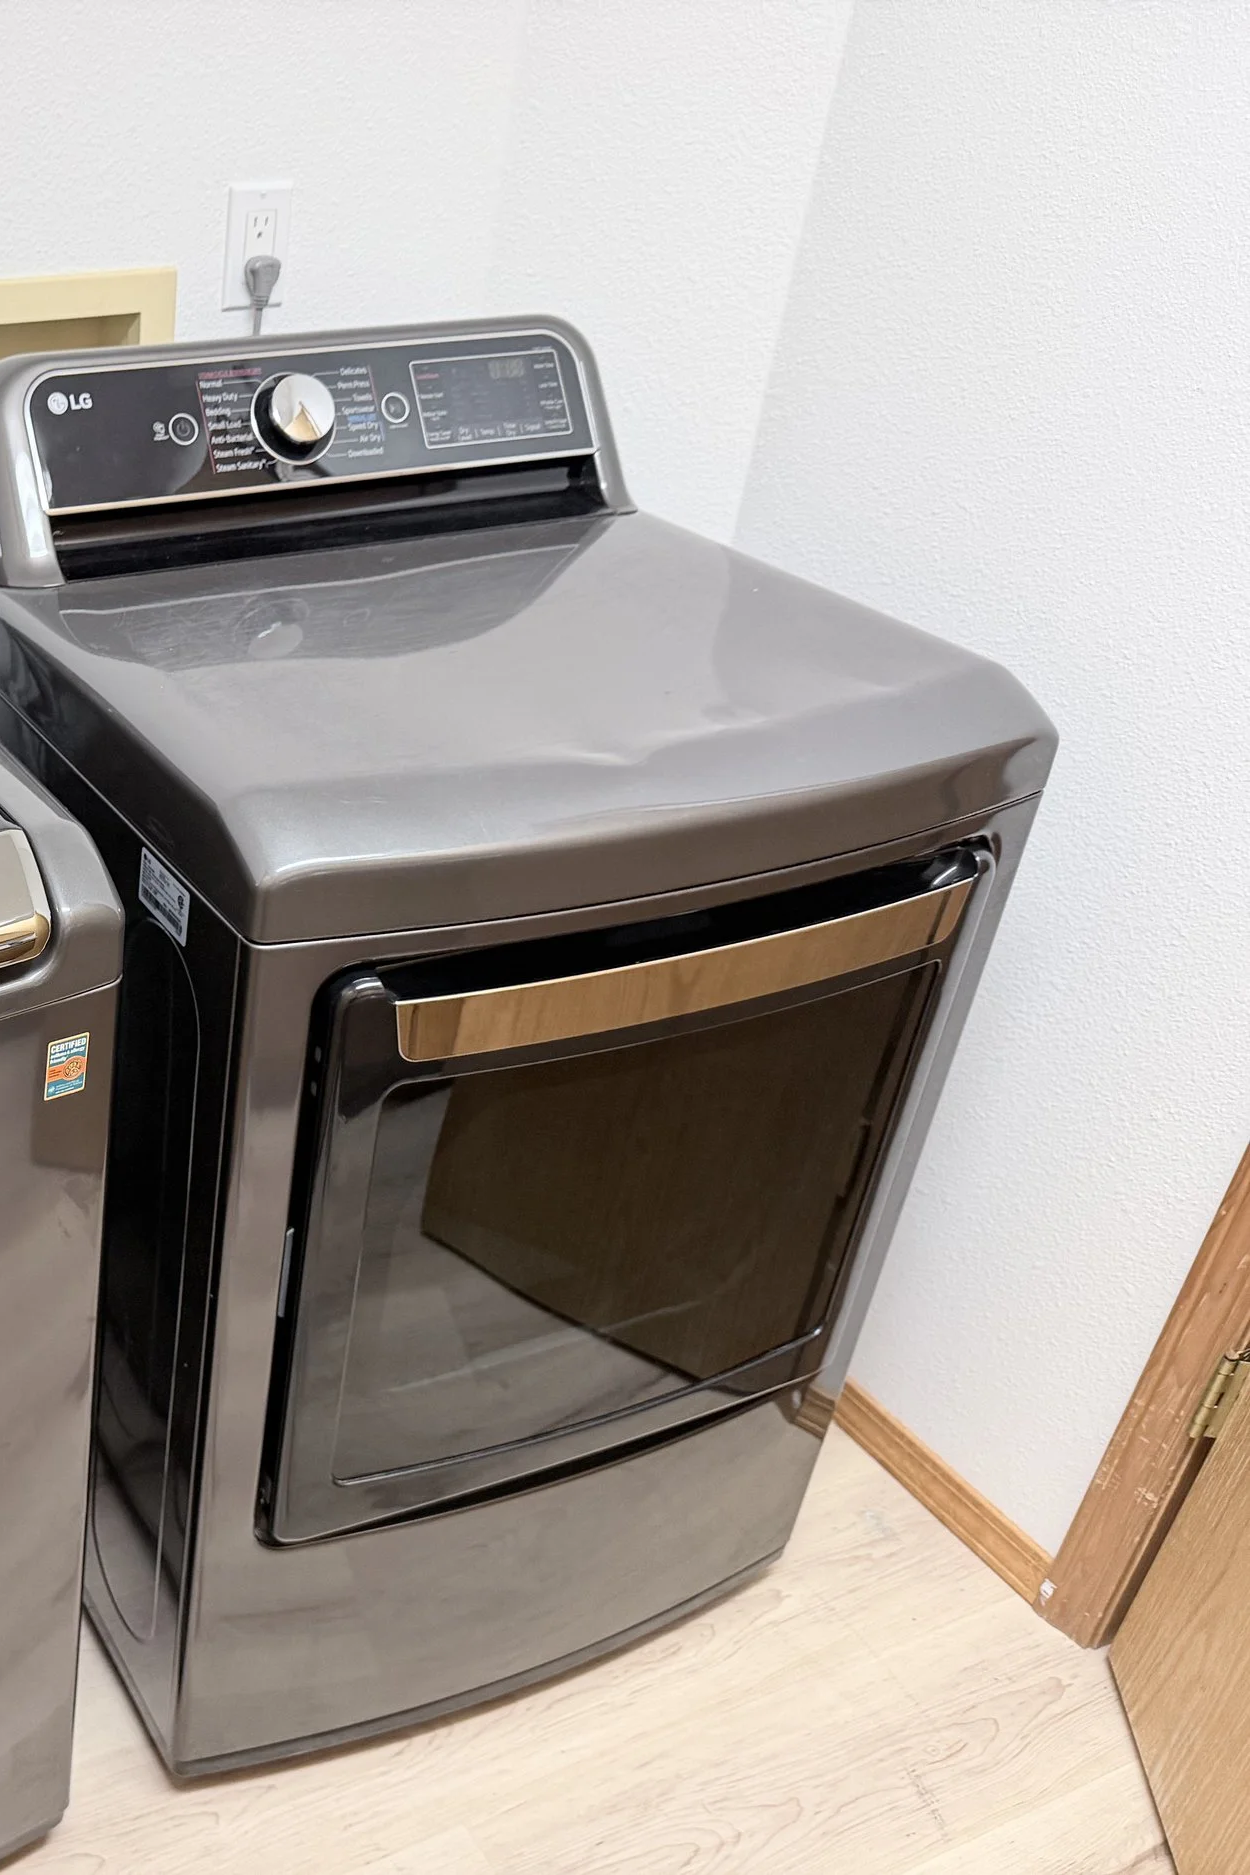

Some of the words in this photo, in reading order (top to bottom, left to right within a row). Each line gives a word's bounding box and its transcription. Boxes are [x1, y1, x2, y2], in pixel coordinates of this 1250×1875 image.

[69, 392, 93, 410] LG
[202, 394, 222, 403] Heavy
[222, 392, 238, 402] Duty
[205, 407, 232, 417] Bedding
[51, 1037, 87, 1055] CERTIFIED
